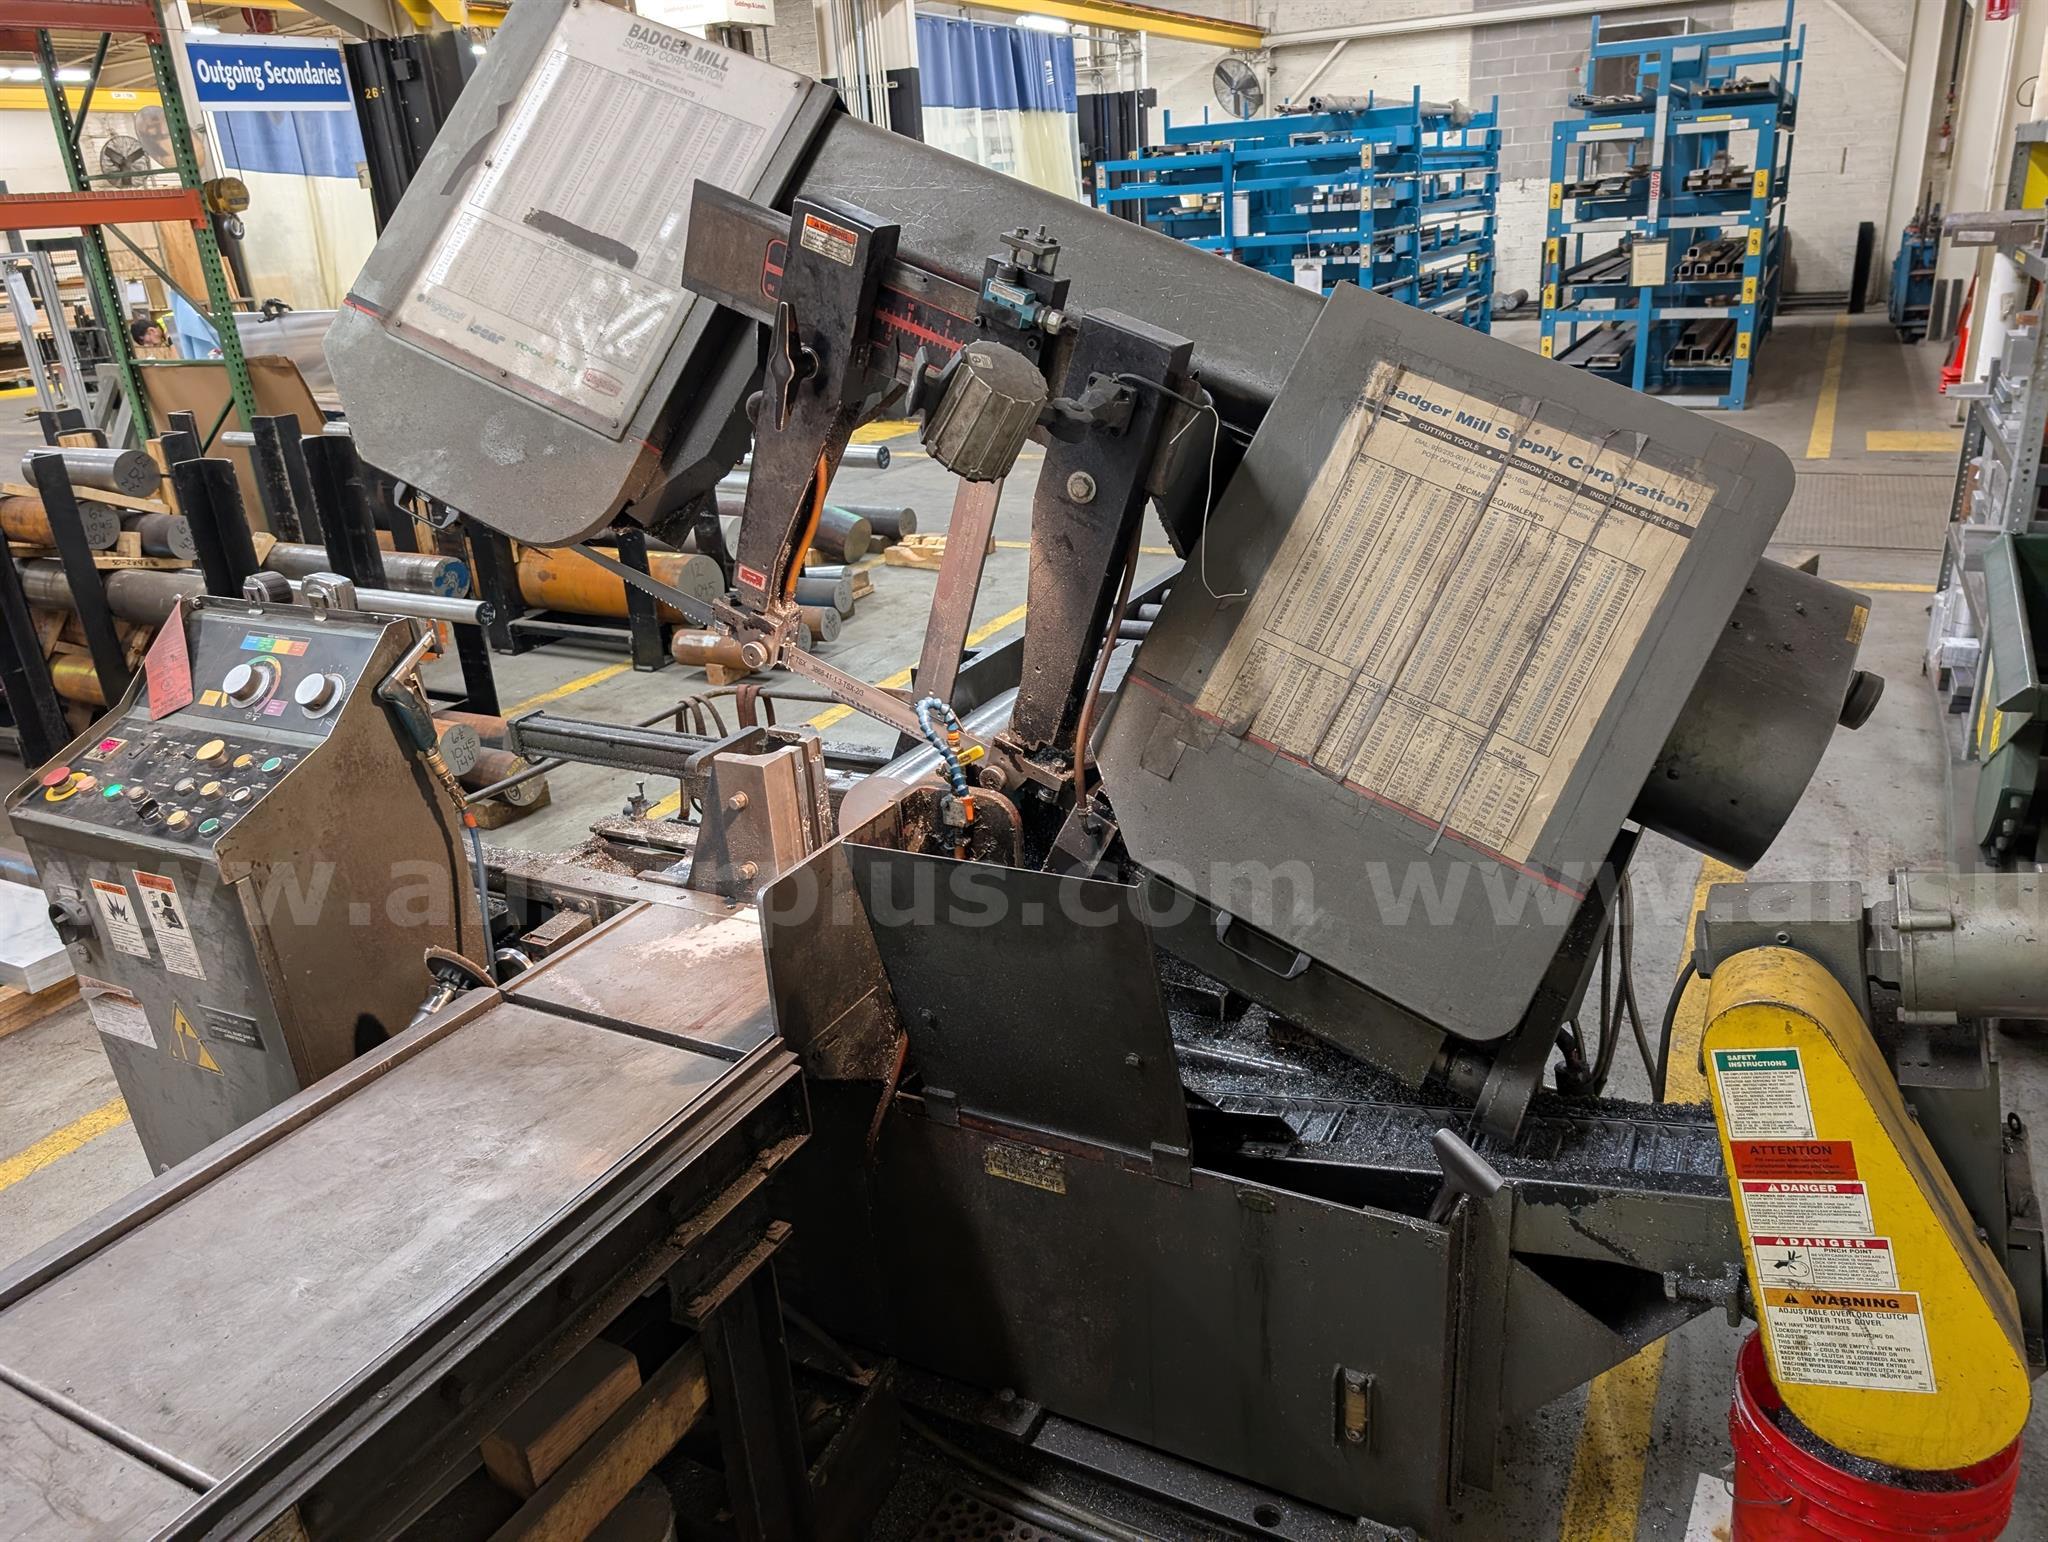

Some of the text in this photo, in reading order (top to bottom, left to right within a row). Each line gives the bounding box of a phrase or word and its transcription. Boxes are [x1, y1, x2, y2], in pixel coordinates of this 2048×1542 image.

[628, 24, 693, 57] BADGER
[694, 47, 730, 72] MILL
[622, 38, 658, 59] SUPPLY
[658, 50, 726, 81] CORPORATION
[197, 59, 341, 91] Outgoing Secondaries
[365, 87, 379, 98] 26
[1456, 411, 1492, 434] Mill
[1418, 423, 1452, 440] CUTTING
[1454, 436, 1480, 451] TOOLS
[1542, 471, 1570, 487] TOOLS
[1639, 510, 1680, 531] SUPPLIES
[1455, 483, 1544, 522] DECIMA EQUIVALENTS
[1573, 501, 1605, 516] MEDALIS
[796, 657, 807, 667] TSX
[1407, 697, 1430, 713] SIZES
[452, 738, 476, 760] 1045
[456, 751, 475, 772] 144
[1750, 1146, 1832, 1155] ATTENTION
[1781, 1184, 1838, 1192] DANGER
[1790, 1238, 1866, 1247] DANGER
[1811, 1295, 1900, 1309] WARNING
[1778, 1308, 1828, 1316] ADJUSTABLE
[1830, 1310, 1873, 1319] OVERLOAD
[1856, 1349, 1886, 1357] FORWARD
[1879, 1372, 1901, 1380] INJURY
